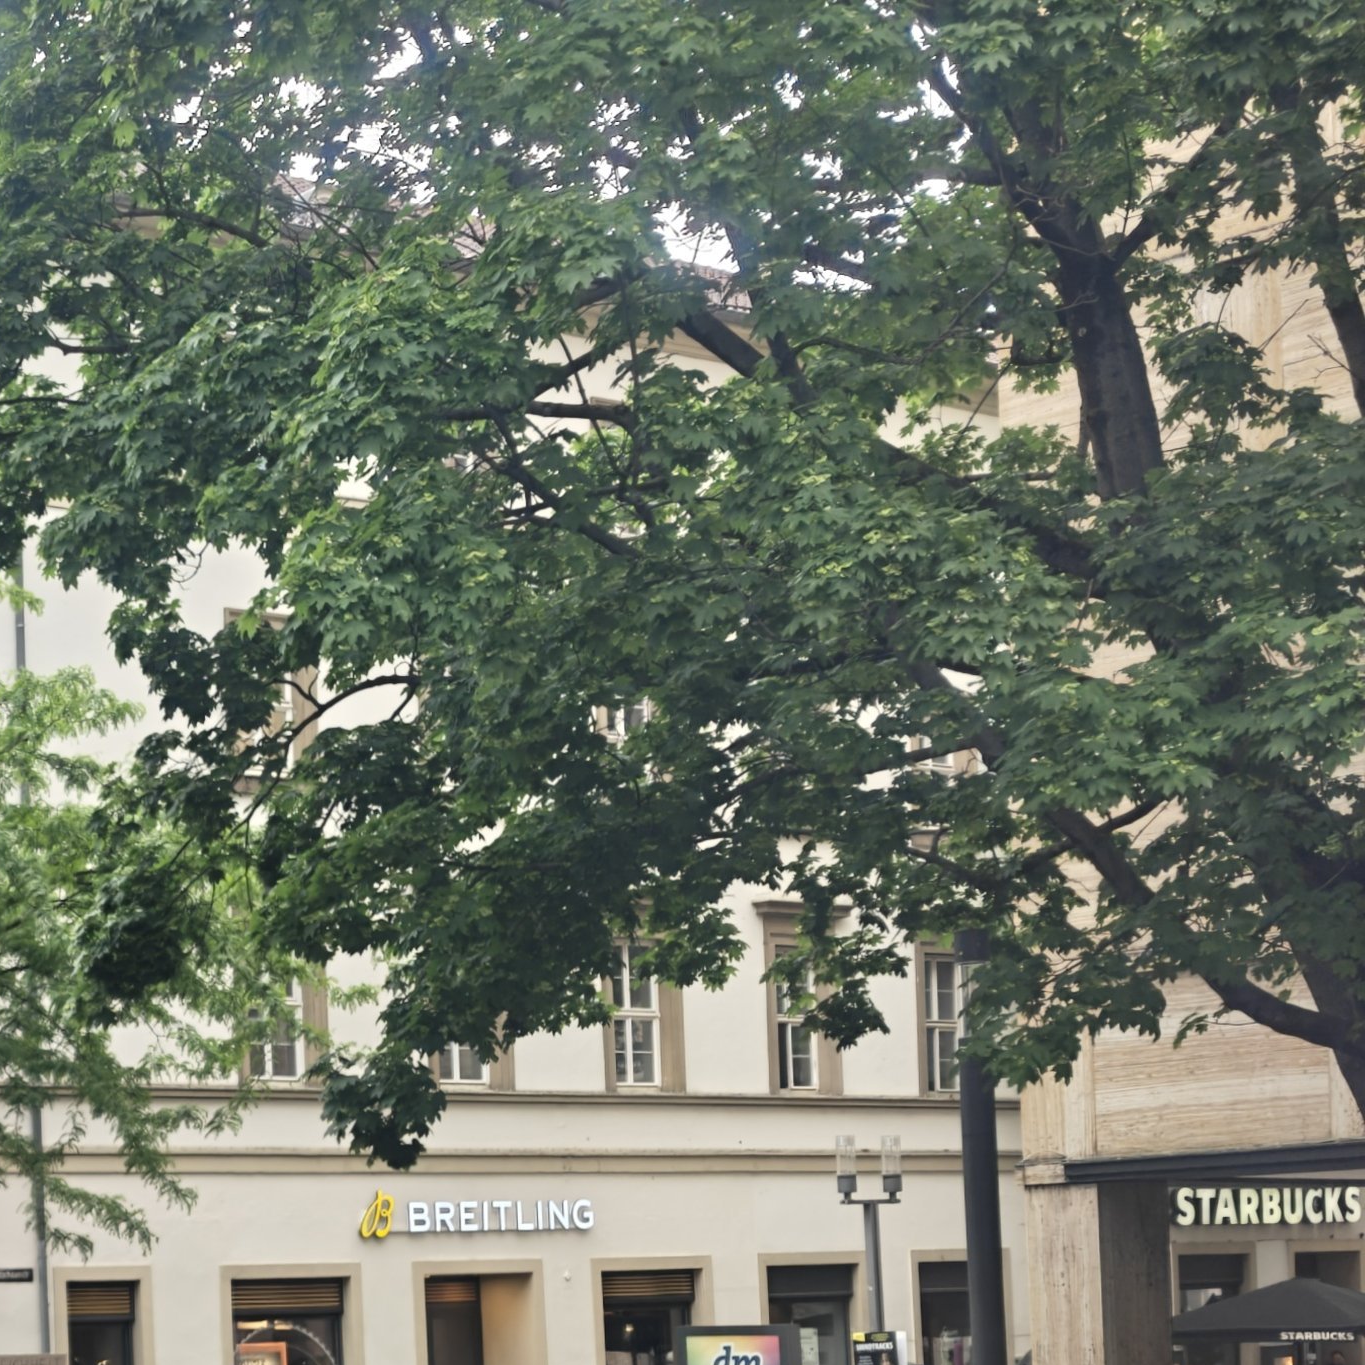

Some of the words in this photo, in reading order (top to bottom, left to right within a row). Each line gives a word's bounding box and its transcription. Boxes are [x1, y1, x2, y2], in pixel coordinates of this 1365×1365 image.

[407, 1199, 595, 1233] BREITLING
[1176, 1186, 1362, 1226] STARBUCKS
[1279, 1331, 1355, 1341] STARBUCKS
